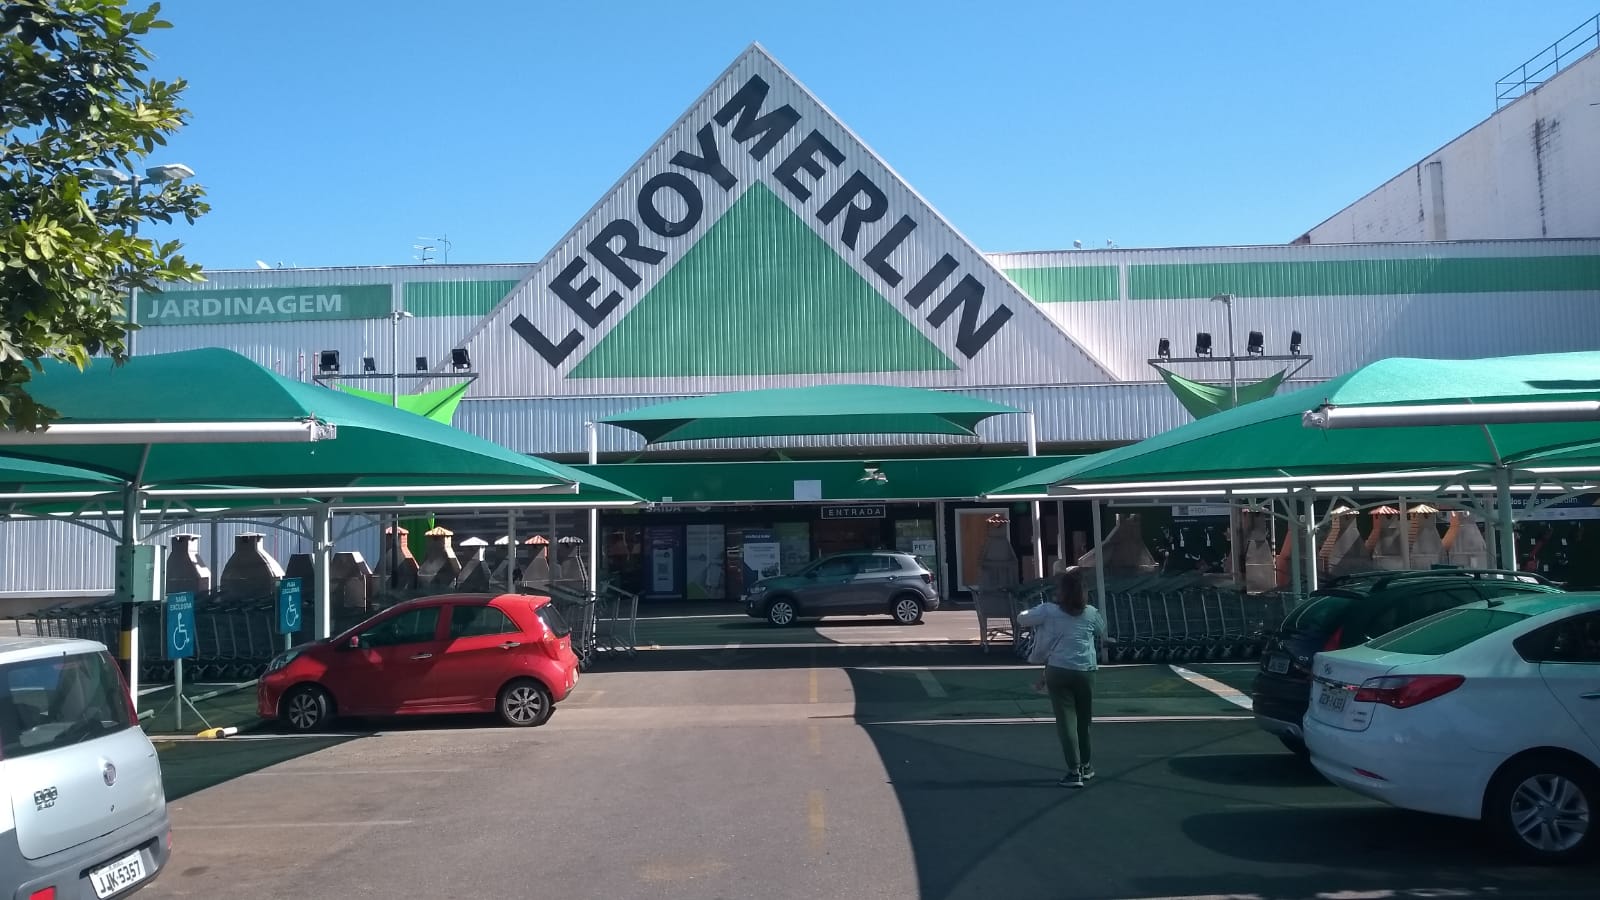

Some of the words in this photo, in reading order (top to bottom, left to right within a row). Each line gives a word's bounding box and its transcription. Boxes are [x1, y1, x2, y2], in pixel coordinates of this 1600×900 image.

[713, 73, 1013, 359] MERLIN
[510, 121, 738, 368] LEROY
[147, 293, 342, 320] JARDINAGEM
[828, 508, 881, 517] ENTRADA
[99, 860, 142, 894] JJK-5357
